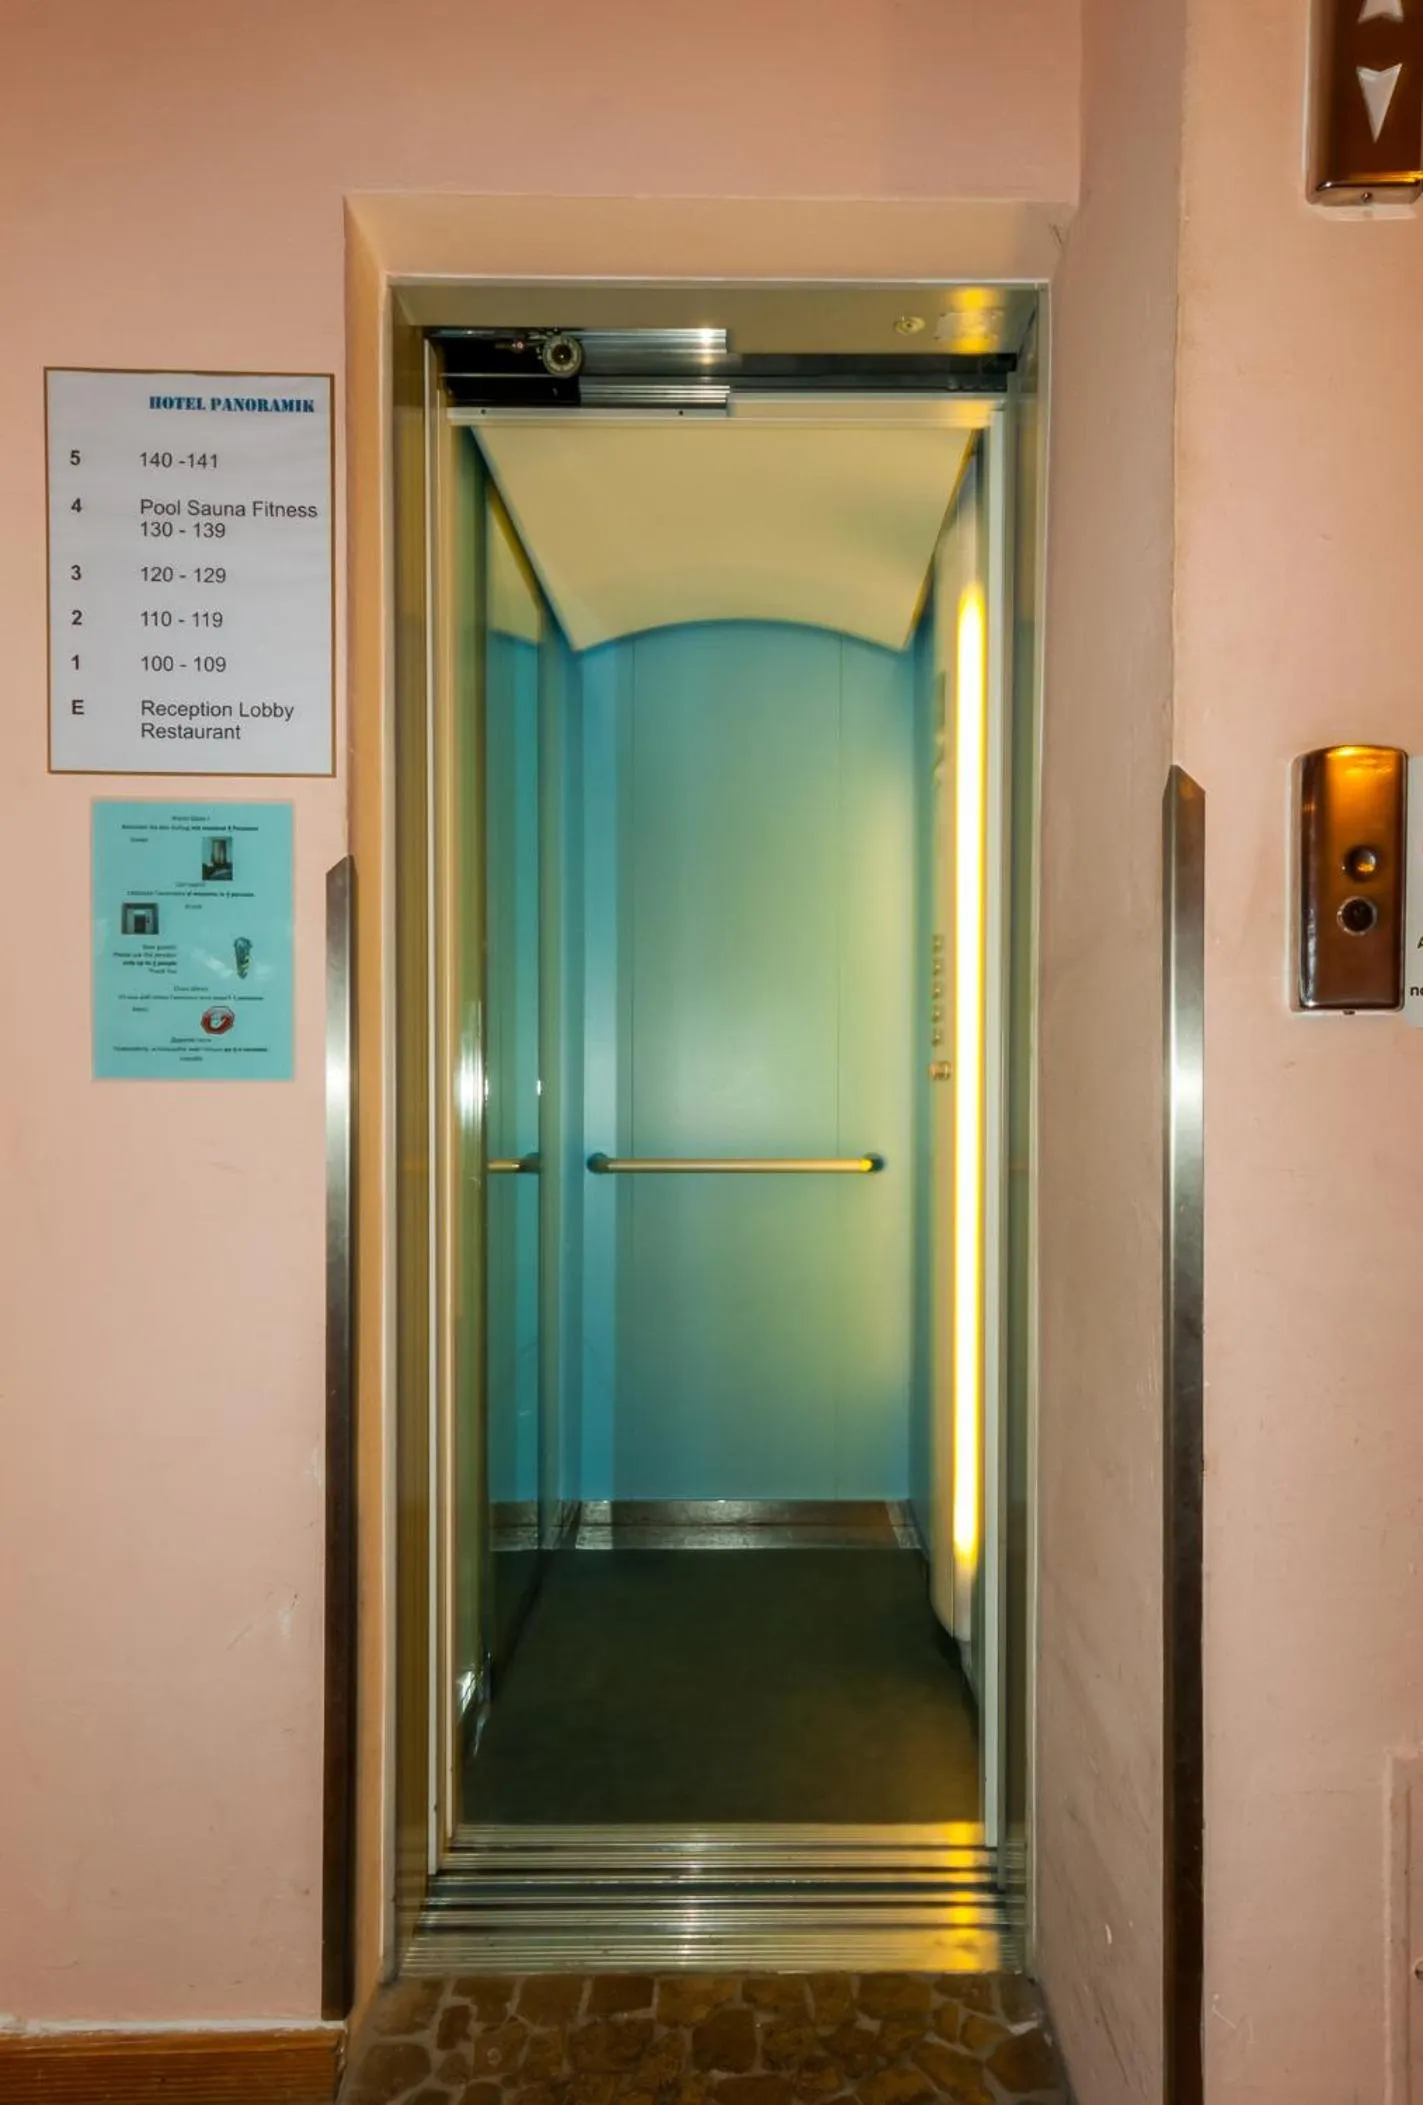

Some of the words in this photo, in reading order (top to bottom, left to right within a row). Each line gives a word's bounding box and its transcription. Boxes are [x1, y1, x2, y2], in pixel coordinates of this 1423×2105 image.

[149, 395, 206, 411] HOTEL
[210, 397, 315, 413] PANORAMIK
[69, 450, 81, 466] 5
[140, 452, 173, 468] 140
[70, 498, 83, 513] 4
[140, 499, 181, 516] Pool
[187, 500, 246, 518] Sauna
[252, 501, 318, 518] Fitness
[140, 521, 173, 538] 130
[194, 522, 226, 539] 139
[70, 565, 82, 581] 3
[140, 567, 174, 583] 120
[194, 567, 227, 584] 129
[71, 610, 83, 626] 2
[140, 611, 173, 628] 110
[192, 612, 224, 629] 119
[71, 655, 80, 670] 1
[141, 655, 174, 672] 100
[193, 656, 227, 673] 109
[71, 700, 85, 716] E
[141, 700, 233, 721] Reception
[239, 701, 294, 722] Lobby
[141, 723, 241, 740] Restaurant
